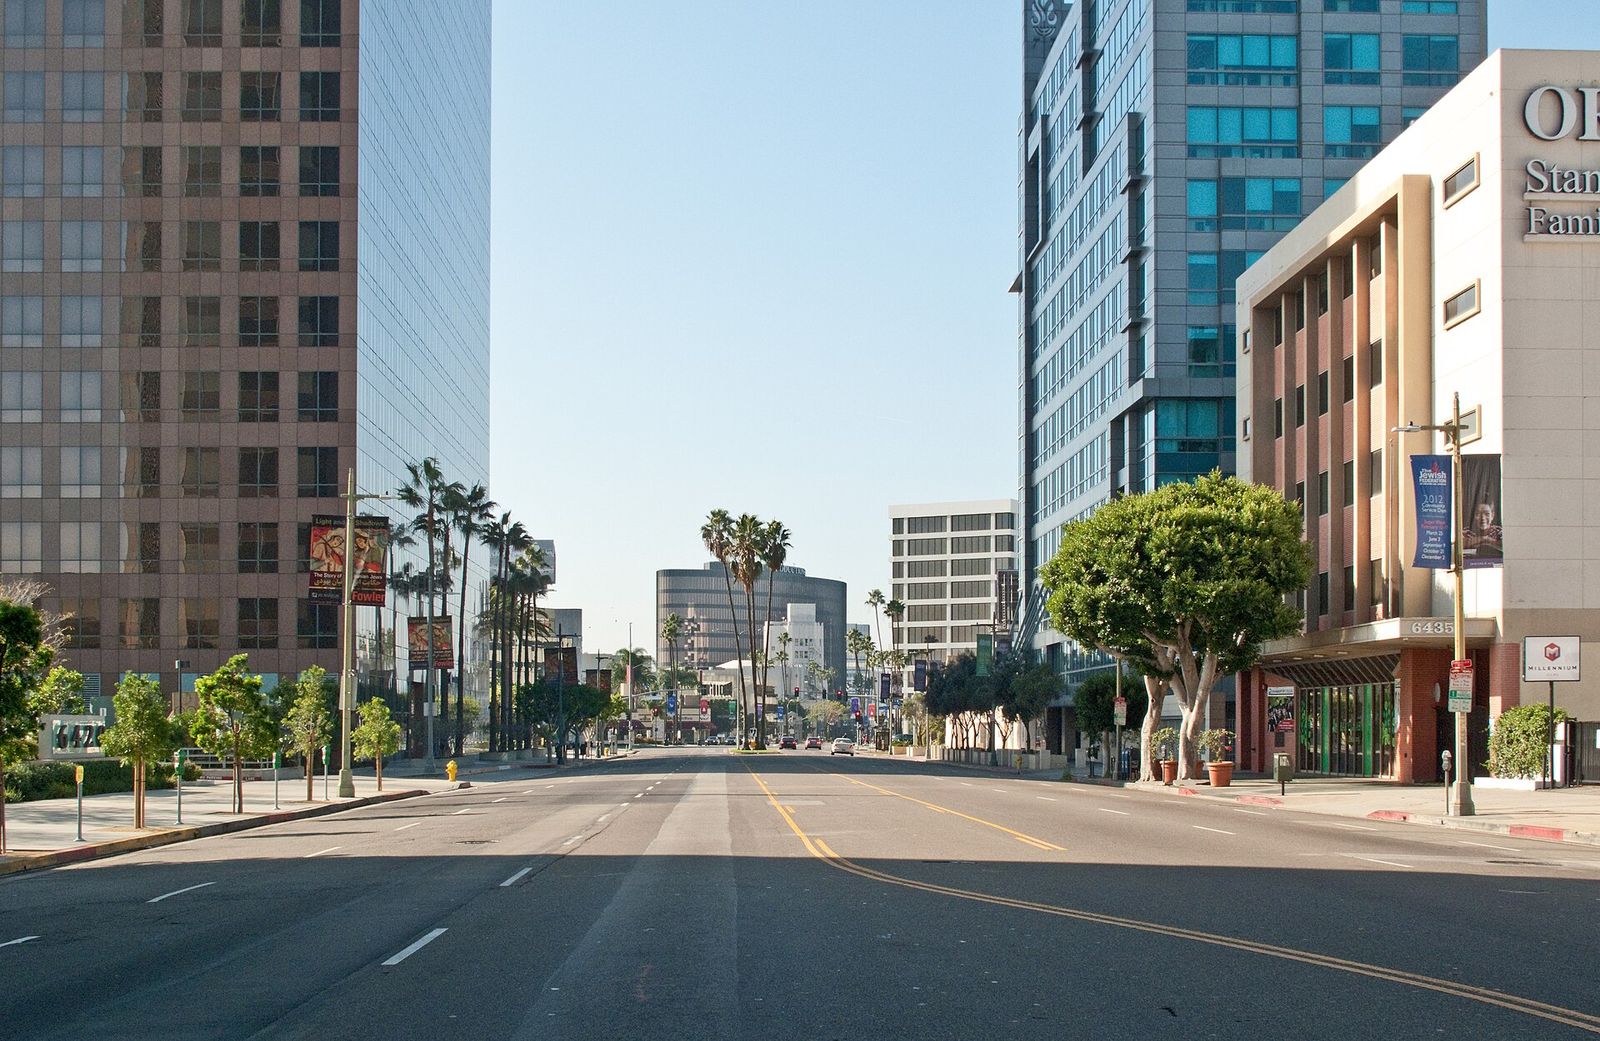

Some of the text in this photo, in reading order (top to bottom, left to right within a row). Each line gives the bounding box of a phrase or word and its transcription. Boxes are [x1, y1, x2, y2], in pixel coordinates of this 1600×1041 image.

[1525, 159, 1600, 193] Stan
[1419, 471, 1447, 479] Jewish
[1423, 495, 1444, 504] 2012
[352, 591, 384, 602] Fowler
[1411, 621, 1454, 634] 6435
